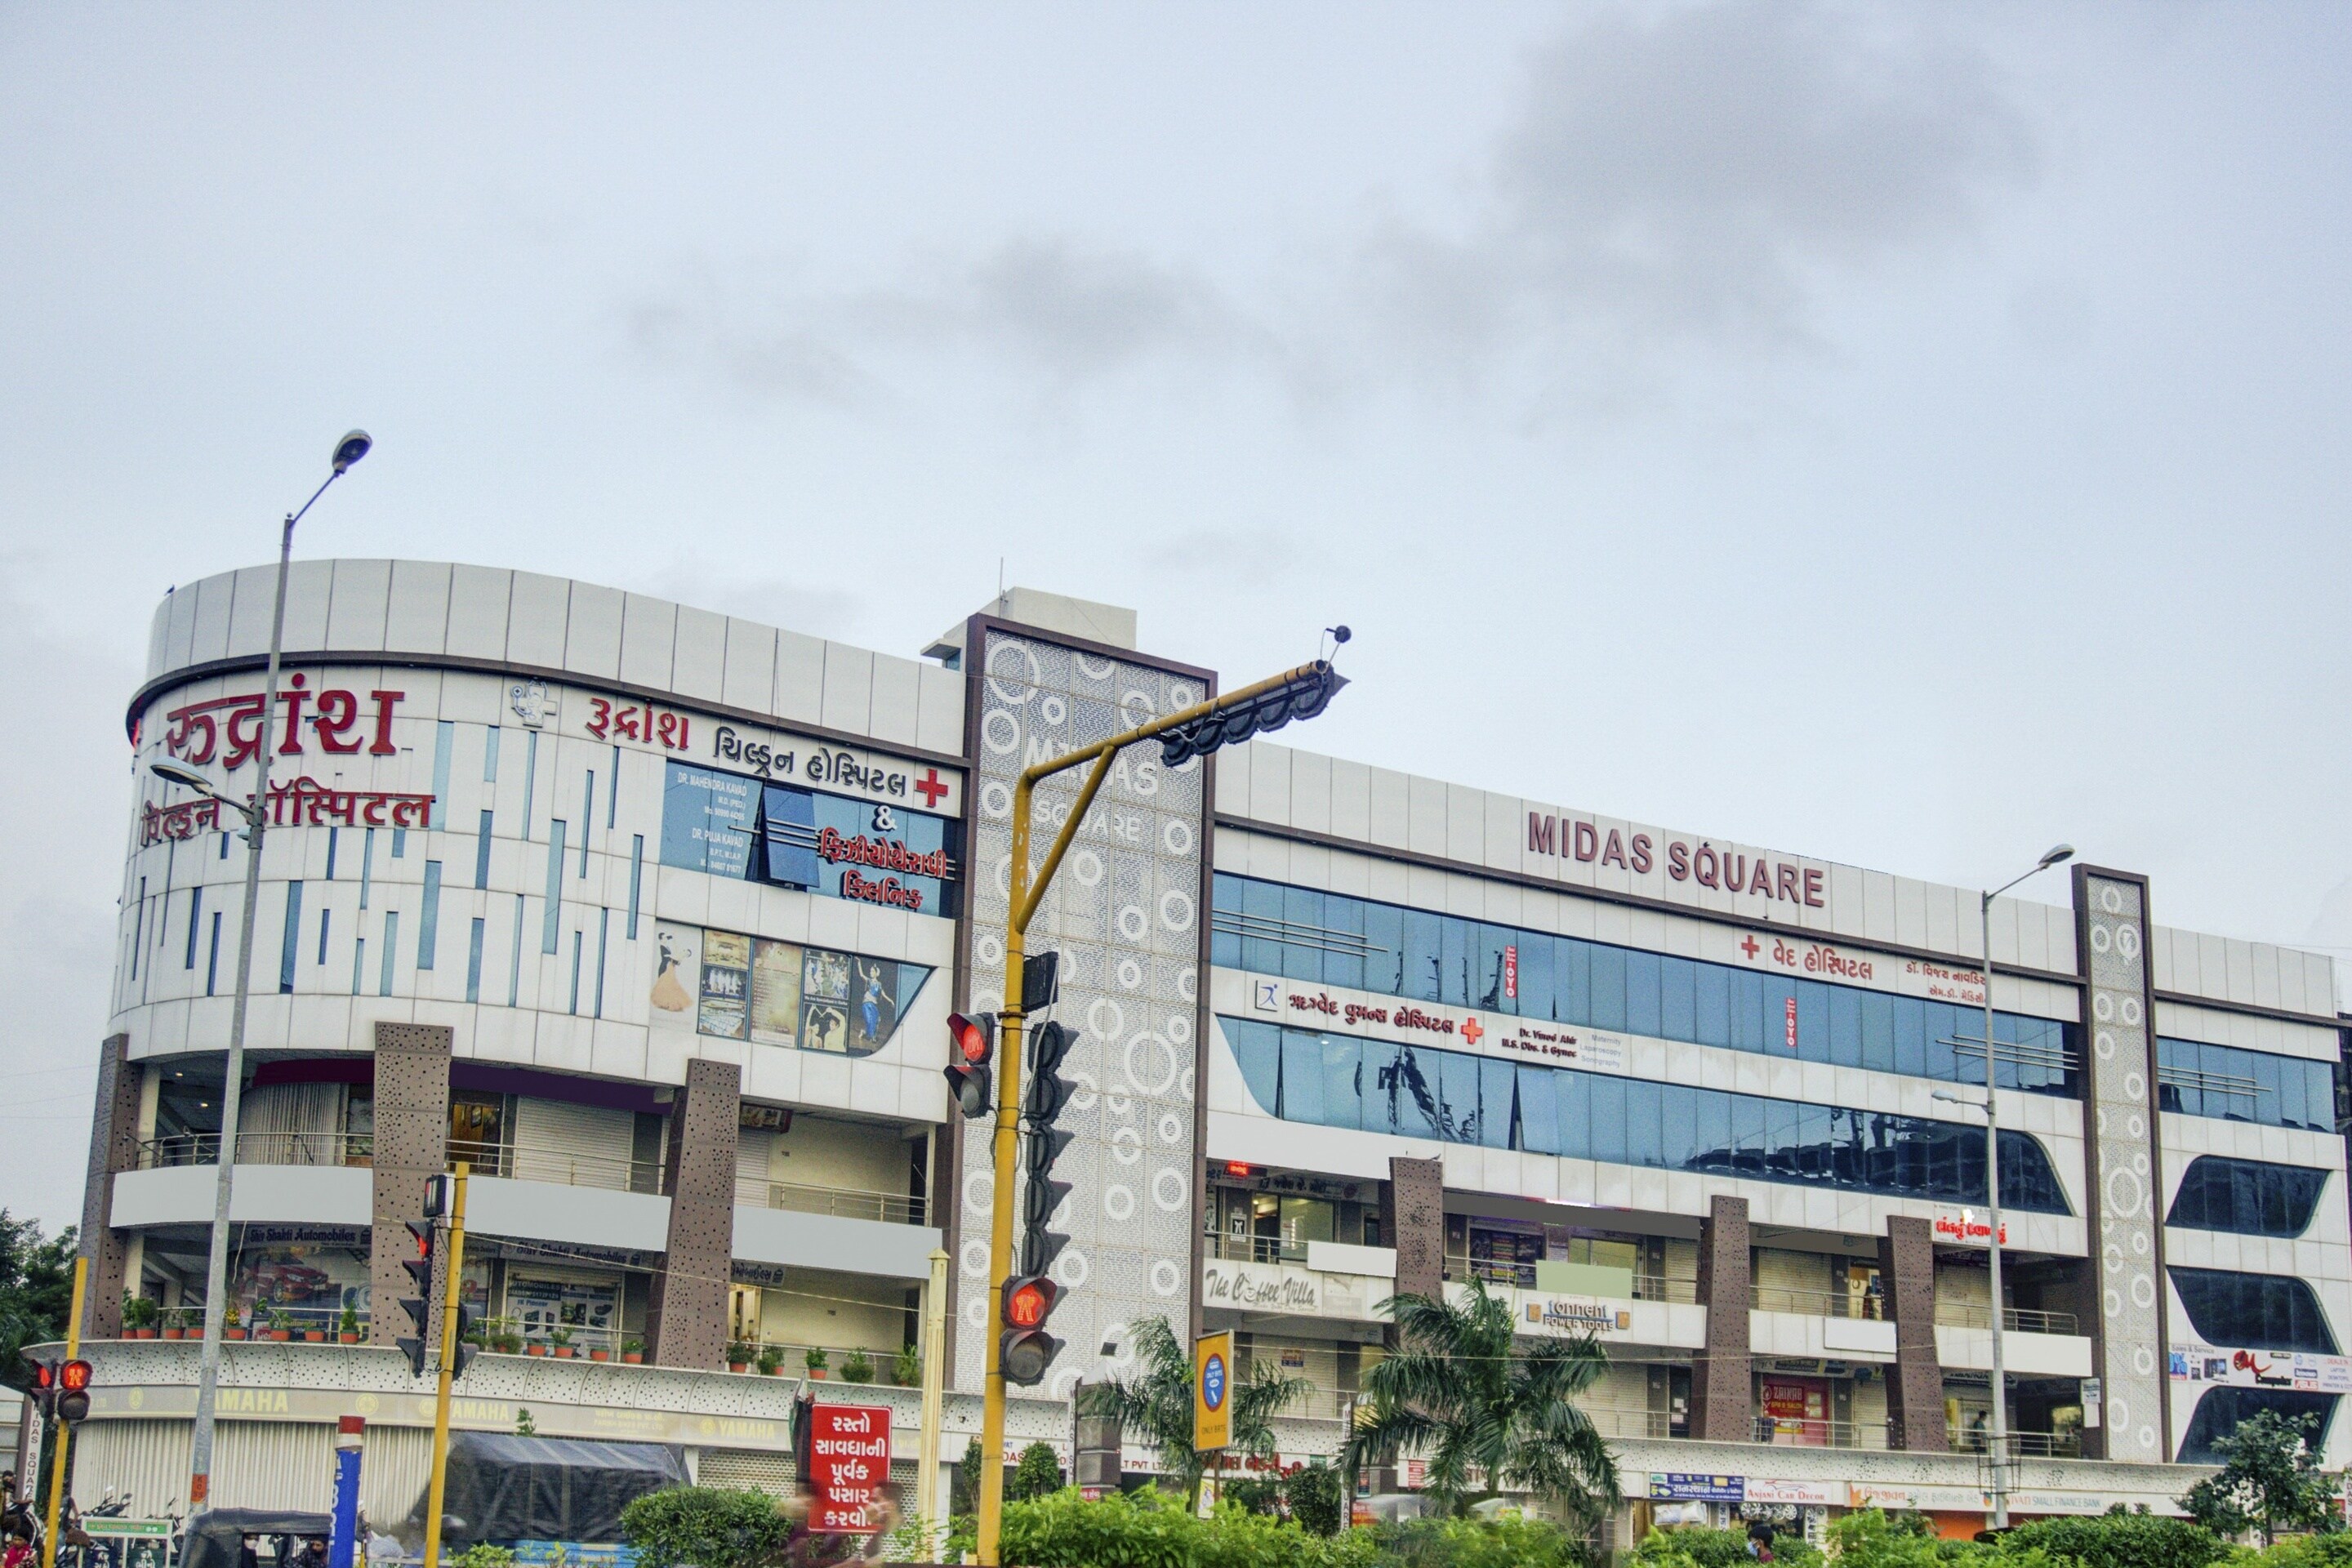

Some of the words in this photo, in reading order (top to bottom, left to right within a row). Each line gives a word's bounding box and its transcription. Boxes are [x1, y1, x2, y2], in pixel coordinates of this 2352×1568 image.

[806, 746, 906, 797] હોસ્પિટલ
[873, 805, 897, 831] &
[1528, 812, 1653, 873] MIDAS
[1668, 841, 1824, 907] SQUARE
[1773, 938, 1797, 967] વેદ
[1804, 945, 1873, 980] હોસ્પિટલ
[1922, 963, 1949, 979] વિજય
[1394, 1006, 1454, 1034] હોસ્પિટલ
[1542, 1045, 1548, 1054] &
[1579, 1044, 1621, 1057] Laparoscopy
[266, 1228, 293, 1241] Shakti
[295, 1227, 356, 1242] Automobiles
[573, 1247, 627, 1264] Automobiles
[1206, 1269, 1228, 1298] The
[1282, 1276, 1316, 1307] Villa
[1544, 1316, 1579, 1330] POWER
[1580, 1319, 1615, 1332] TOOLS
[1773, 1386, 1803, 1401] ZAINAB
[719, 1419, 775, 1441] YAMAHA
[833, 1412, 871, 1433] રસ્તો
[815, 1437, 886, 1458] સાવધાની
[831, 1459, 870, 1486] પૂર્વક
[1132, 1460, 1148, 1470] PVT
[828, 1487, 870, 1503] પસાર
[2032, 1496, 2055, 1506] SMALL
[2055, 1498, 2082, 1507] FINANCE
[2083, 1499, 2101, 1508] BANK
